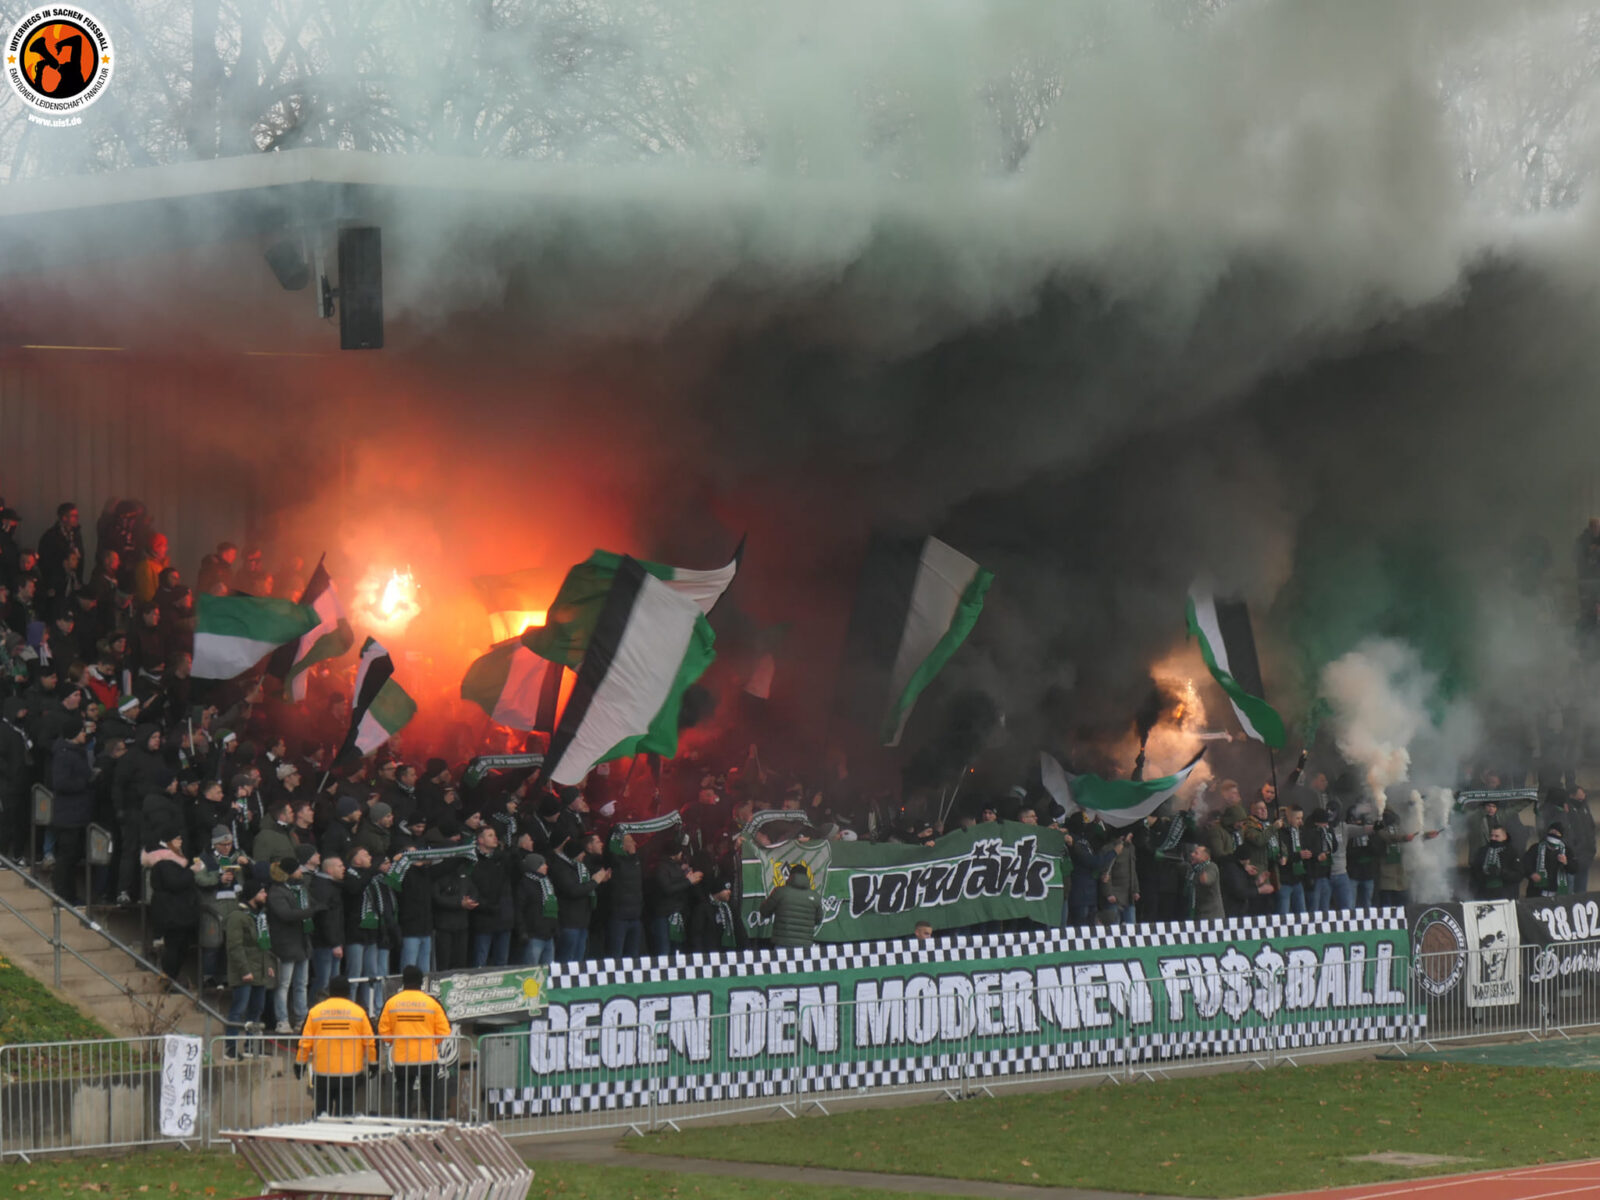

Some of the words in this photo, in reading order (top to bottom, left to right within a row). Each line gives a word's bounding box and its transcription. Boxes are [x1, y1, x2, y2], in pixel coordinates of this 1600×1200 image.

[529, 991, 711, 1076] GEGEN
[728, 983, 840, 1059] DEN
[854, 959, 1154, 1048] MODERNEN
[1158, 941, 1406, 1023] FU$$BALL
